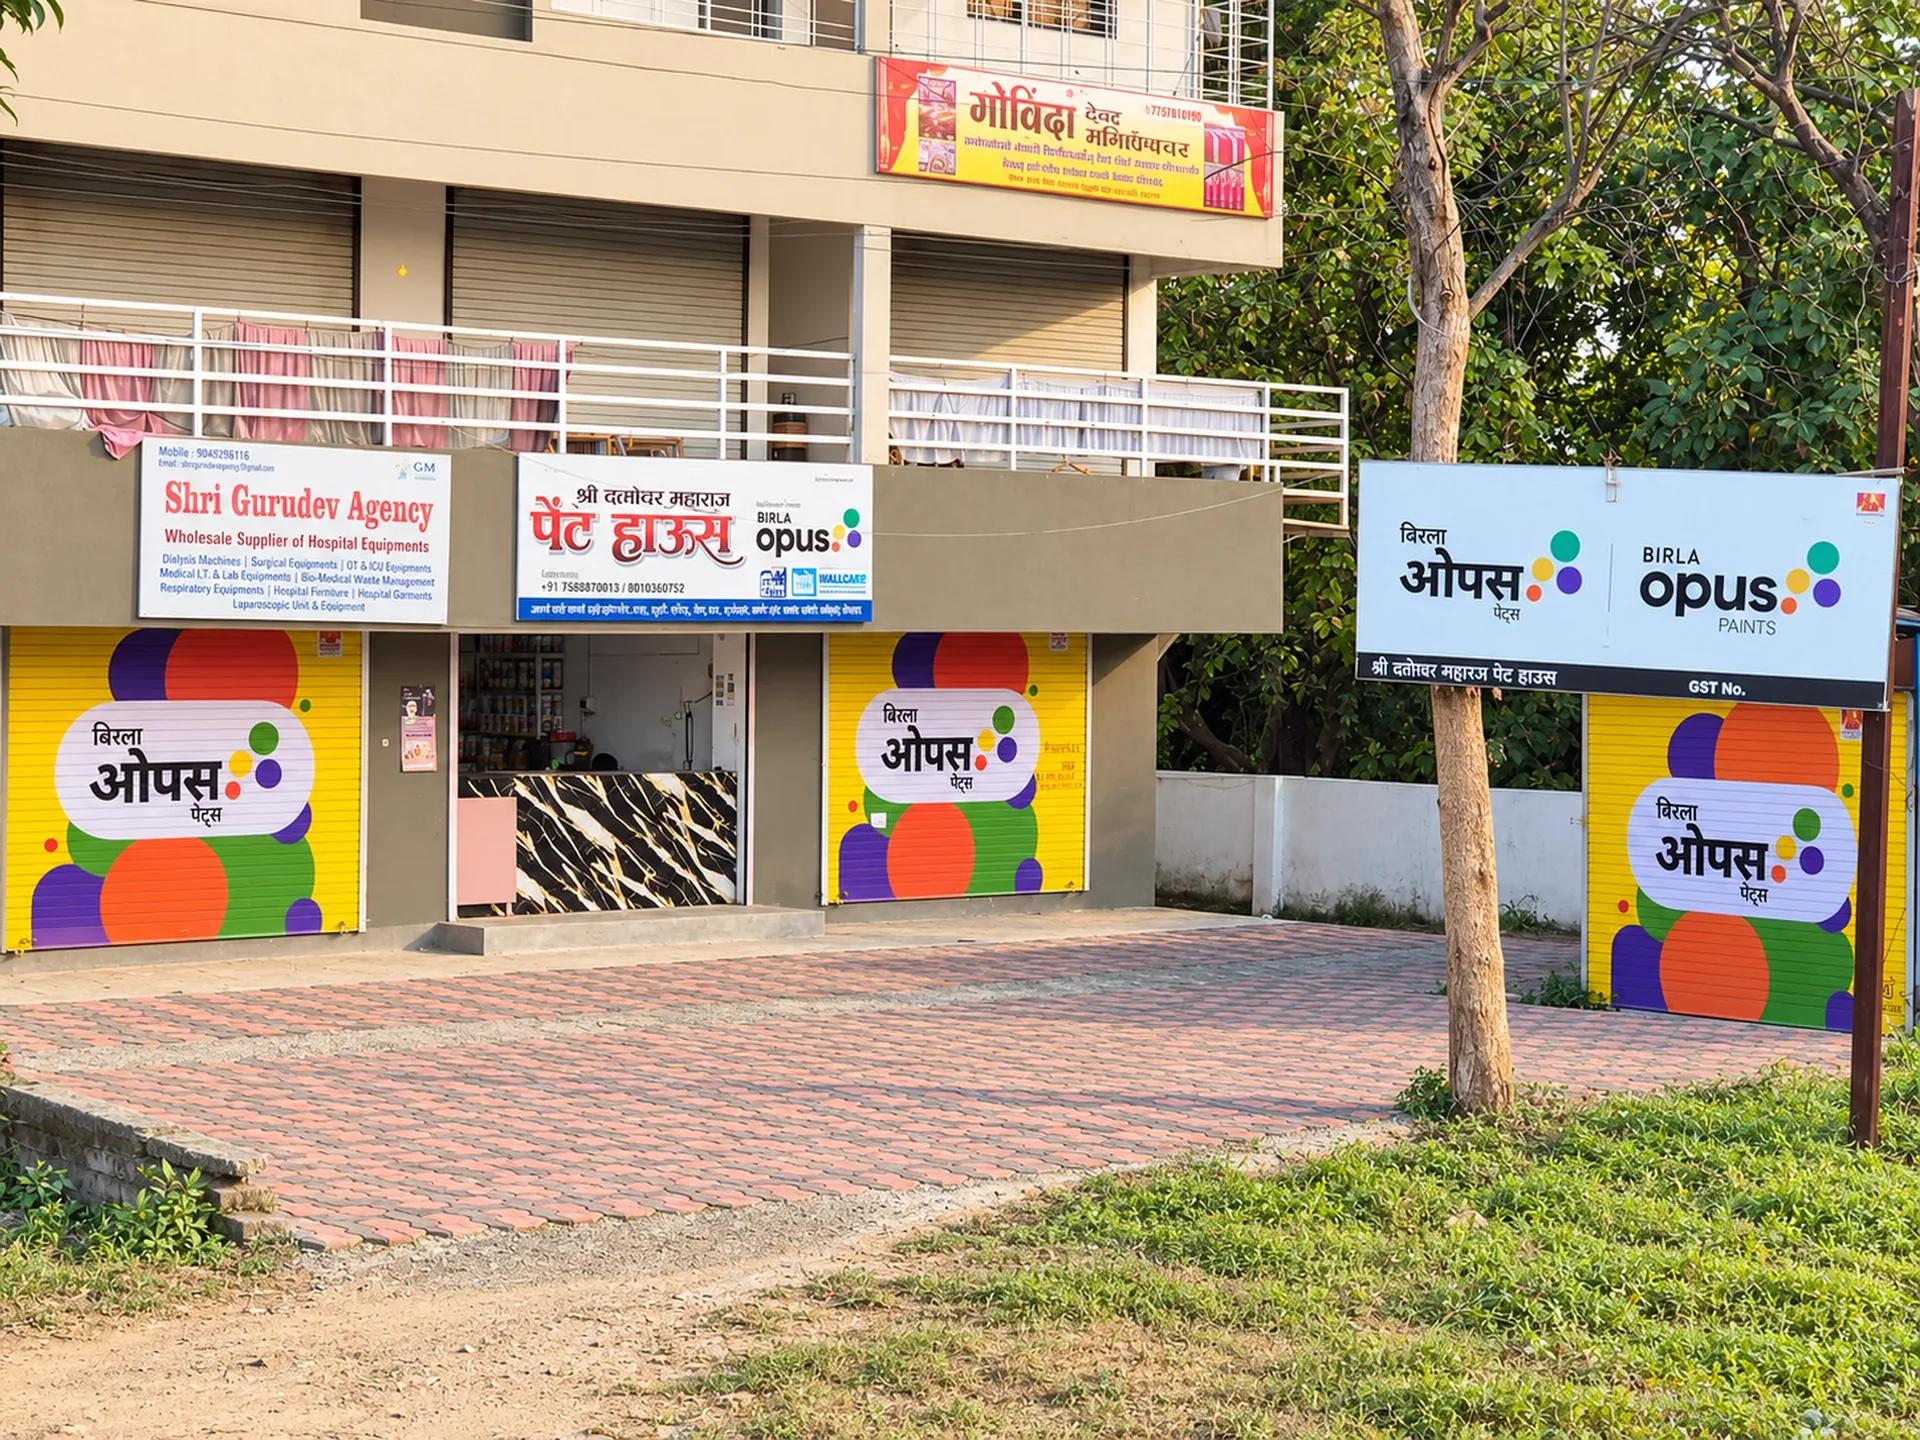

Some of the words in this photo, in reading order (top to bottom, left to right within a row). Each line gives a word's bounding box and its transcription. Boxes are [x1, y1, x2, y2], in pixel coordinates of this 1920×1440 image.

[158, 446, 190, 458] Mobile
[165, 480, 222, 515] Shri
[232, 483, 340, 520] Gurudev
[347, 490, 434, 533] Agency
[576, 484, 598, 504] श्री
[669, 490, 731, 509] महाराज
[530, 496, 597, 552] पेंट
[757, 511, 792, 524] BIRLA
[164, 528, 232, 545] Wholesale
[237, 531, 288, 550] Supplier
[292, 534, 304, 548] of
[308, 535, 358, 552] Hospital
[361, 537, 430, 555] Equipments
[756, 527, 831, 559] opus
[1399, 521, 1448, 545] बिरला
[199, 555, 241, 567] Machines
[251, 556, 287, 569] Surgical
[1643, 546, 1700, 565] BIRLA
[160, 568, 195, 579] Medical
[222, 570, 239, 580] Lab
[1399, 547, 1525, 602] ओपस
[160, 583, 211, 596] Respiratory
[214, 584, 264, 596] Equipments
[274, 586, 309, 598] Hospital
[393, 590, 433, 601] Garments
[1640, 571, 1778, 617] opus
[233, 599, 290, 612] Laparoscopic
[1718, 617, 1777, 636] PAINTS
[1371, 656, 1388, 677] श्री
[1517, 669, 1558, 686] हाउस
[1688, 680, 1719, 695] GST
[1721, 681, 1747, 697] No.
[92, 721, 143, 746] बिरला
[881, 725, 974, 772] ओपस
[89, 747, 223, 803] ओपस
[1656, 796, 1699, 821] बिरला
[1655, 823, 1769, 881] ओपस
